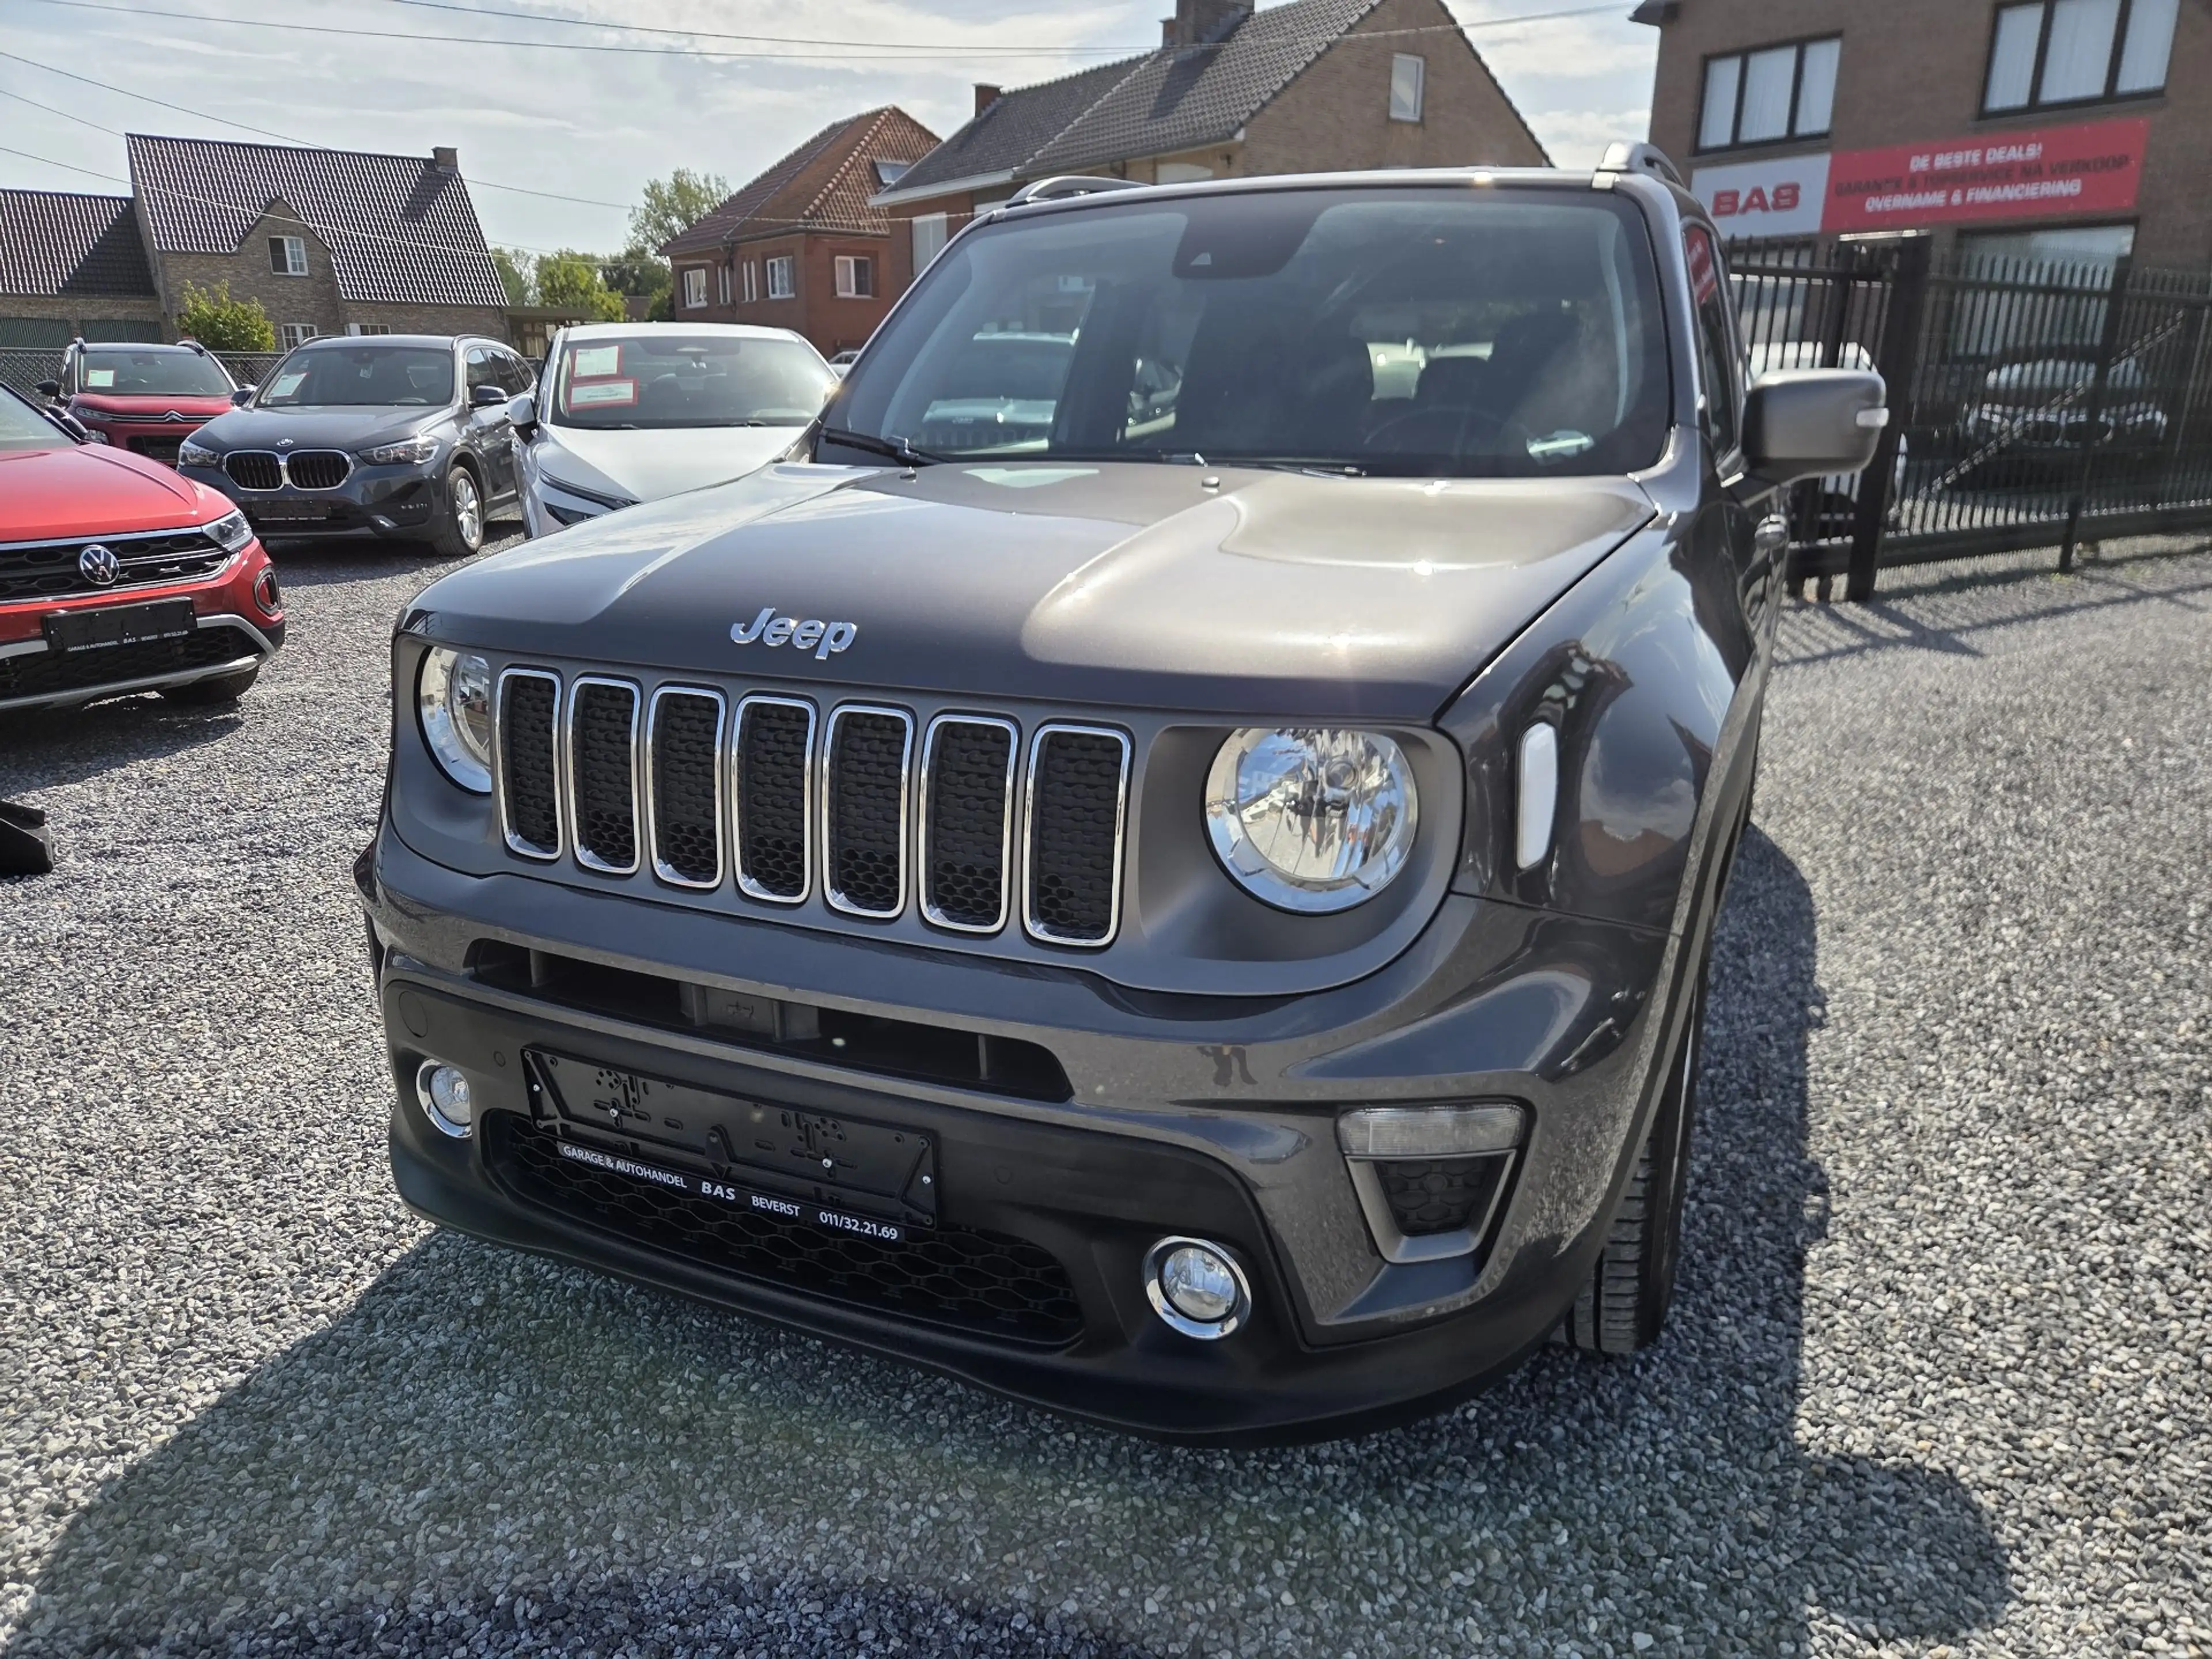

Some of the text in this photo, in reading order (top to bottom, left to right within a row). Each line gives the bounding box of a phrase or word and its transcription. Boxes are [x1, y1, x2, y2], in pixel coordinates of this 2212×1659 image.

[1934, 149, 1982, 170] BESTE
[1985, 142, 2043, 165] DEALS!
[1712, 182, 1801, 217] BAS
[1865, 190, 1947, 213] OVERNAME
[1965, 178, 2082, 203] FINANCIERING
[730, 607, 858, 660] Jeep
[563, 1146, 898, 1240] GARAGE & AUTOHANDEL BAS BEVERST 011/32.21.69
